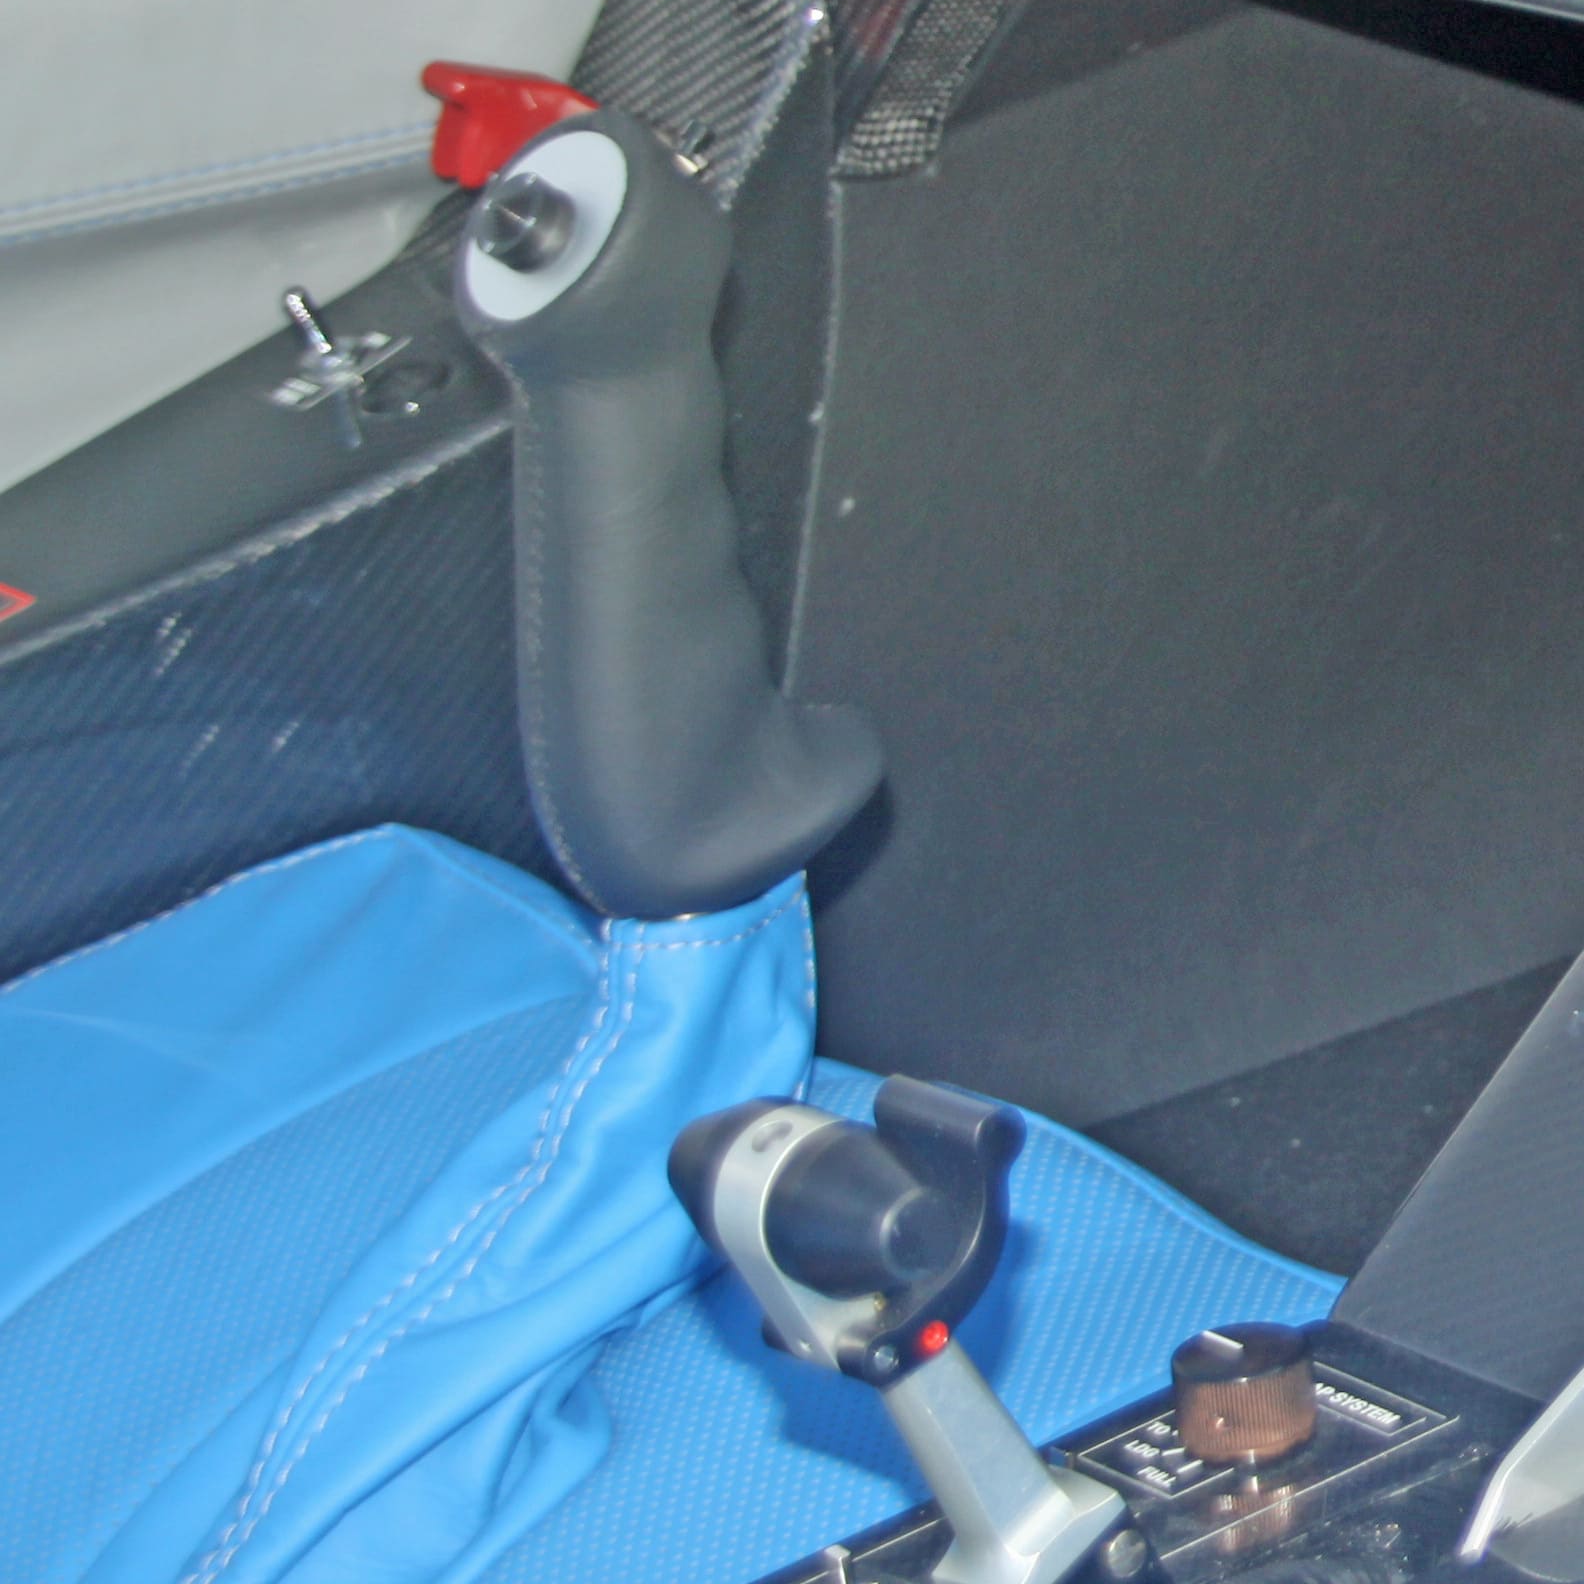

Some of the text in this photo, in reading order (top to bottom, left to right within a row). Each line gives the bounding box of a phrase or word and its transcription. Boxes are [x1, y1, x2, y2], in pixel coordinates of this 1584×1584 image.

[1331, 1389, 1402, 1425] SYSTEM
[1148, 1420, 1171, 1436] TO
[1124, 1439, 1162, 1459] LDG
[1136, 1465, 1178, 1488] FULL
